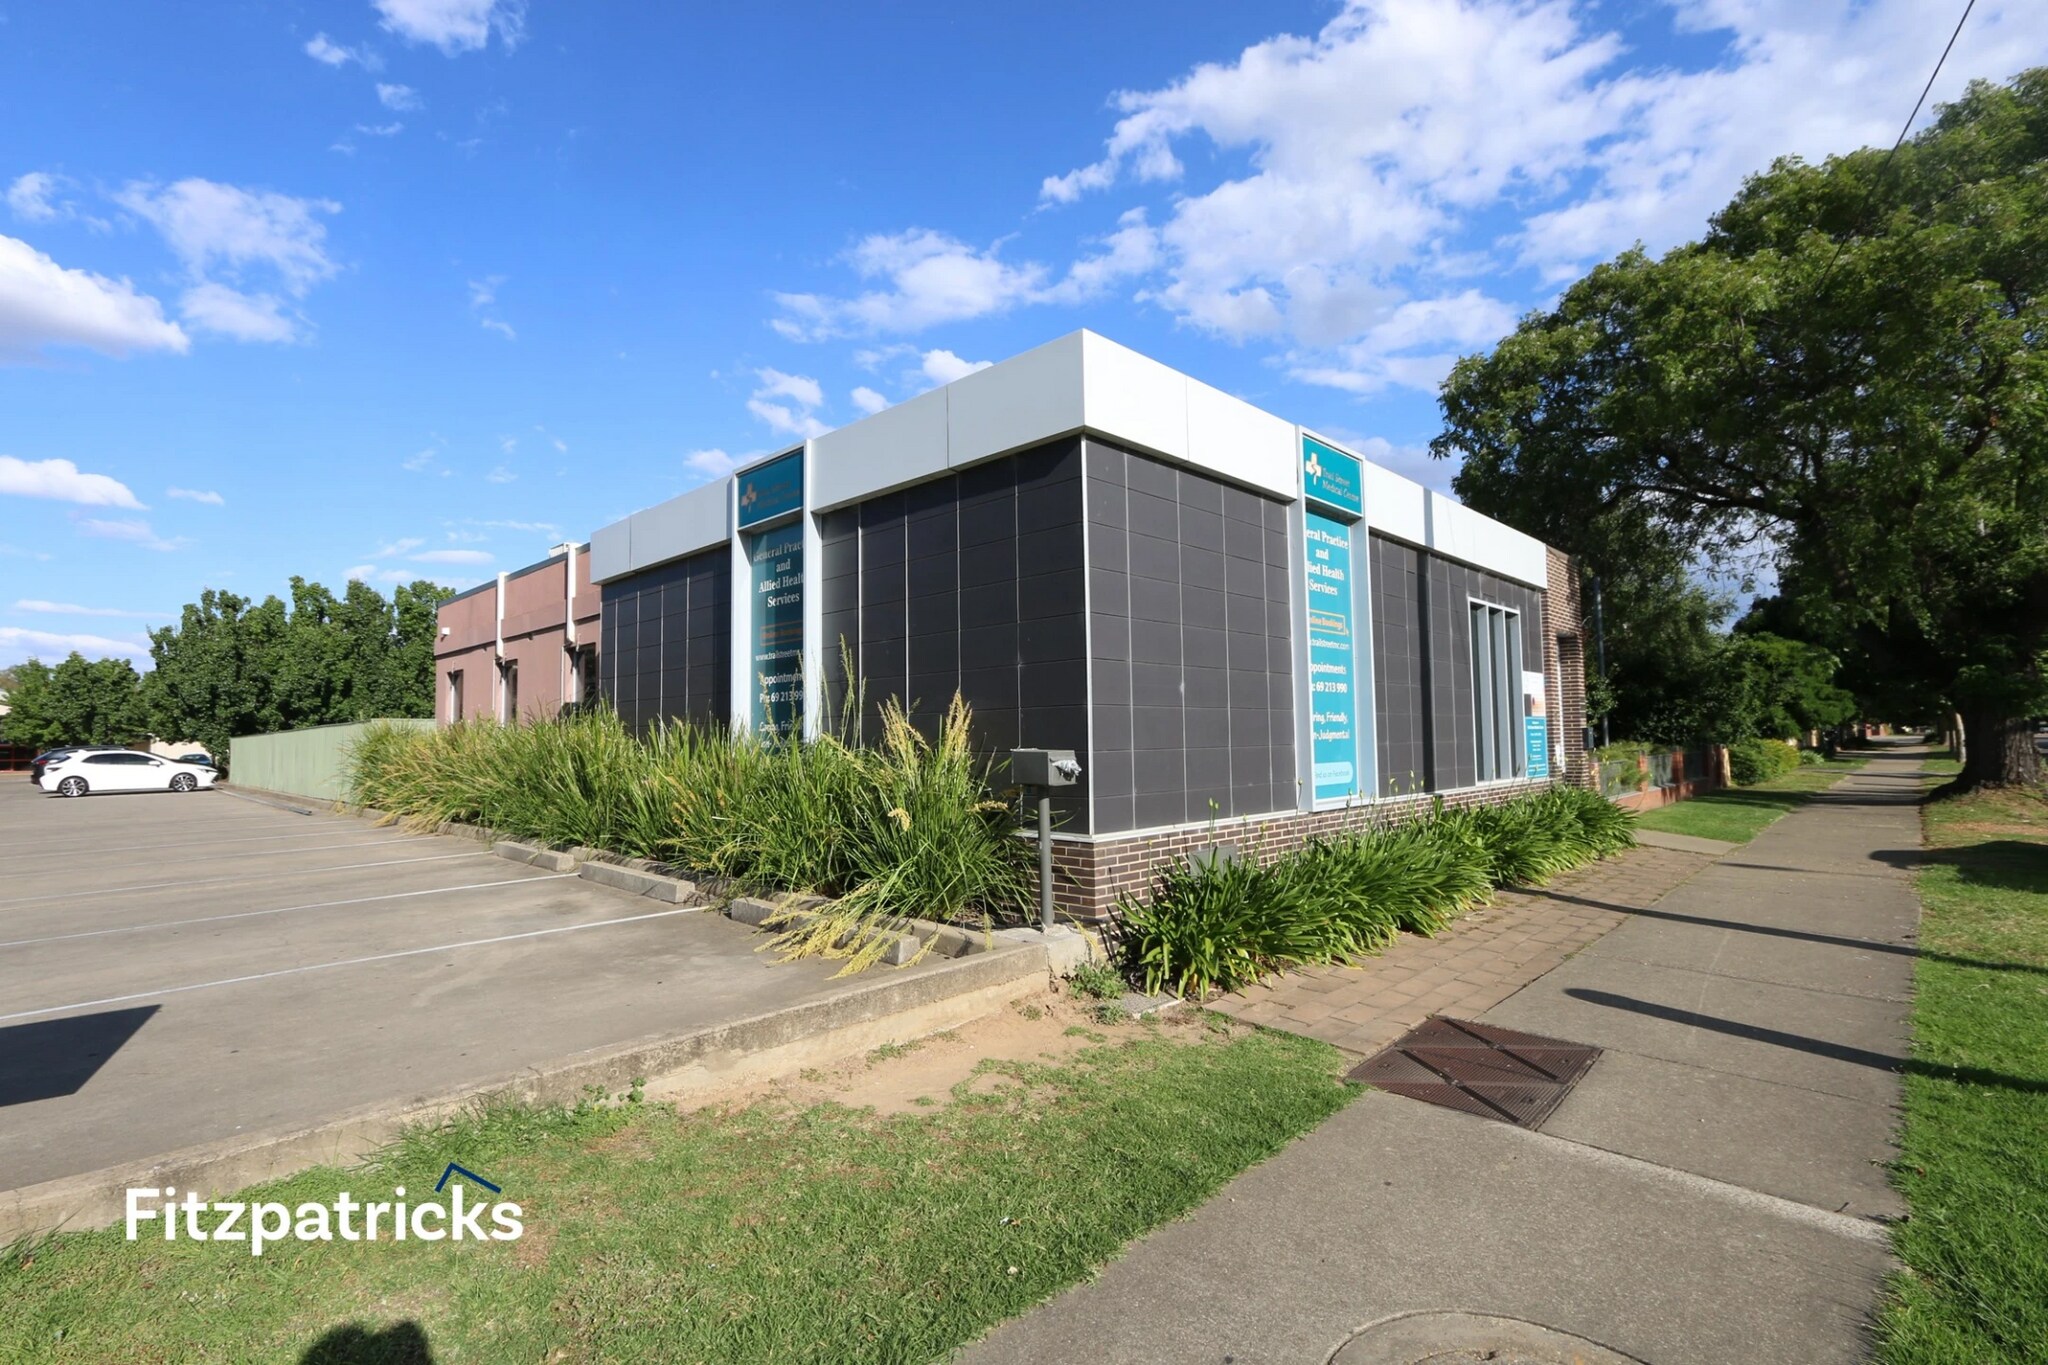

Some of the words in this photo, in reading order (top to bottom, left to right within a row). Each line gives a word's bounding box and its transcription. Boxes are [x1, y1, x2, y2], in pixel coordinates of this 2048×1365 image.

[1321, 531, 1348, 549] Practice
[1315, 548, 1329, 560] and
[776, 558, 791, 573] and
[1321, 564, 1344, 581] Health
[758, 577, 780, 593] Allied
[1308, 579, 1338, 595] Services
[767, 593, 800, 608] Services
[1316, 681, 1325, 692] 69
[1325, 682, 1336, 693] 213
[1337, 682, 1348, 693] 990
[771, 692, 780, 703] 69
[780, 691, 793, 702] 213
